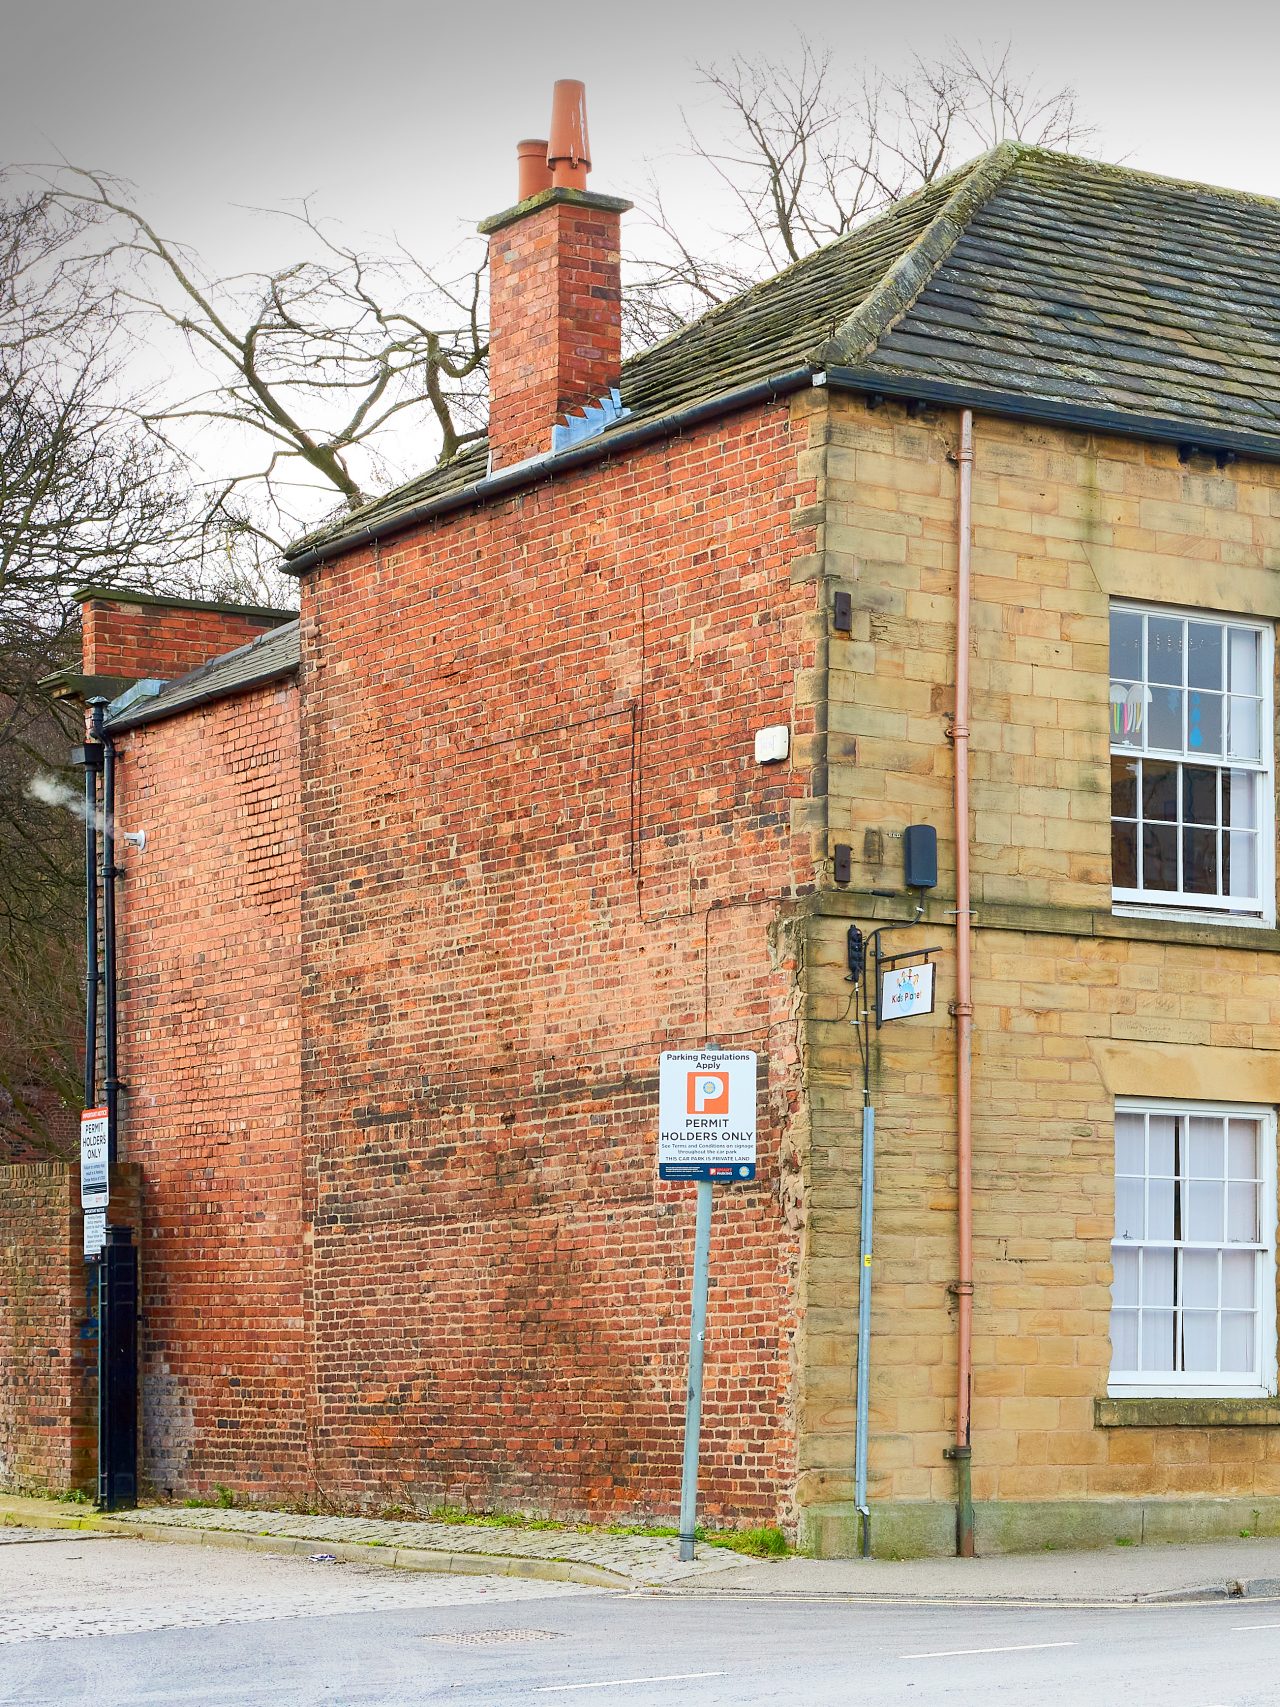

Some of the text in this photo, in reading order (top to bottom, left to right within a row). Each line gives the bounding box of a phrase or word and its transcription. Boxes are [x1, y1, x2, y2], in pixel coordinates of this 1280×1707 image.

[904, 991, 922, 1001] Panet
[696, 1062, 721, 1070] Apply
[694, 1076, 724, 1112] P
[85, 1122, 103, 1134] PERMIT
[685, 1119, 729, 1128] PERMIT
[82, 1134, 106, 1147] HOLDERS
[661, 1132, 754, 1141] HOLDERS ONLY
[87, 1148, 102, 1159] ONLY
